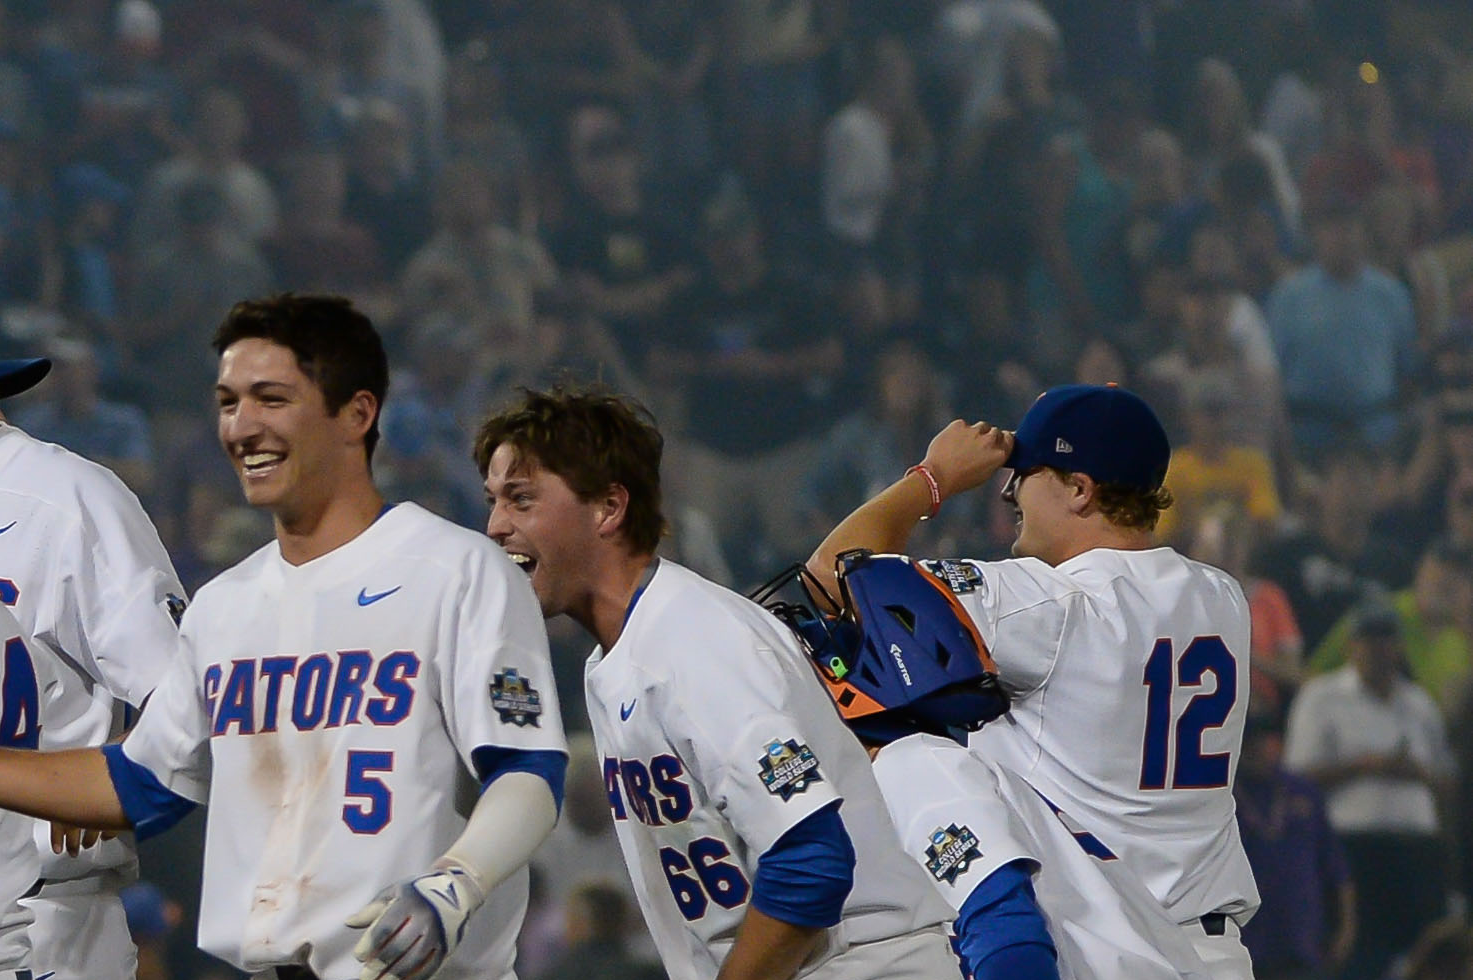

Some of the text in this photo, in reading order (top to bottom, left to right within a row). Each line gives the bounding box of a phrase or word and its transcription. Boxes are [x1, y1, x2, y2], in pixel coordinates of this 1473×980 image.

[1138, 634, 1237, 791] 12
[341, 750, 395, 836] 5
[659, 836, 751, 922] 66
